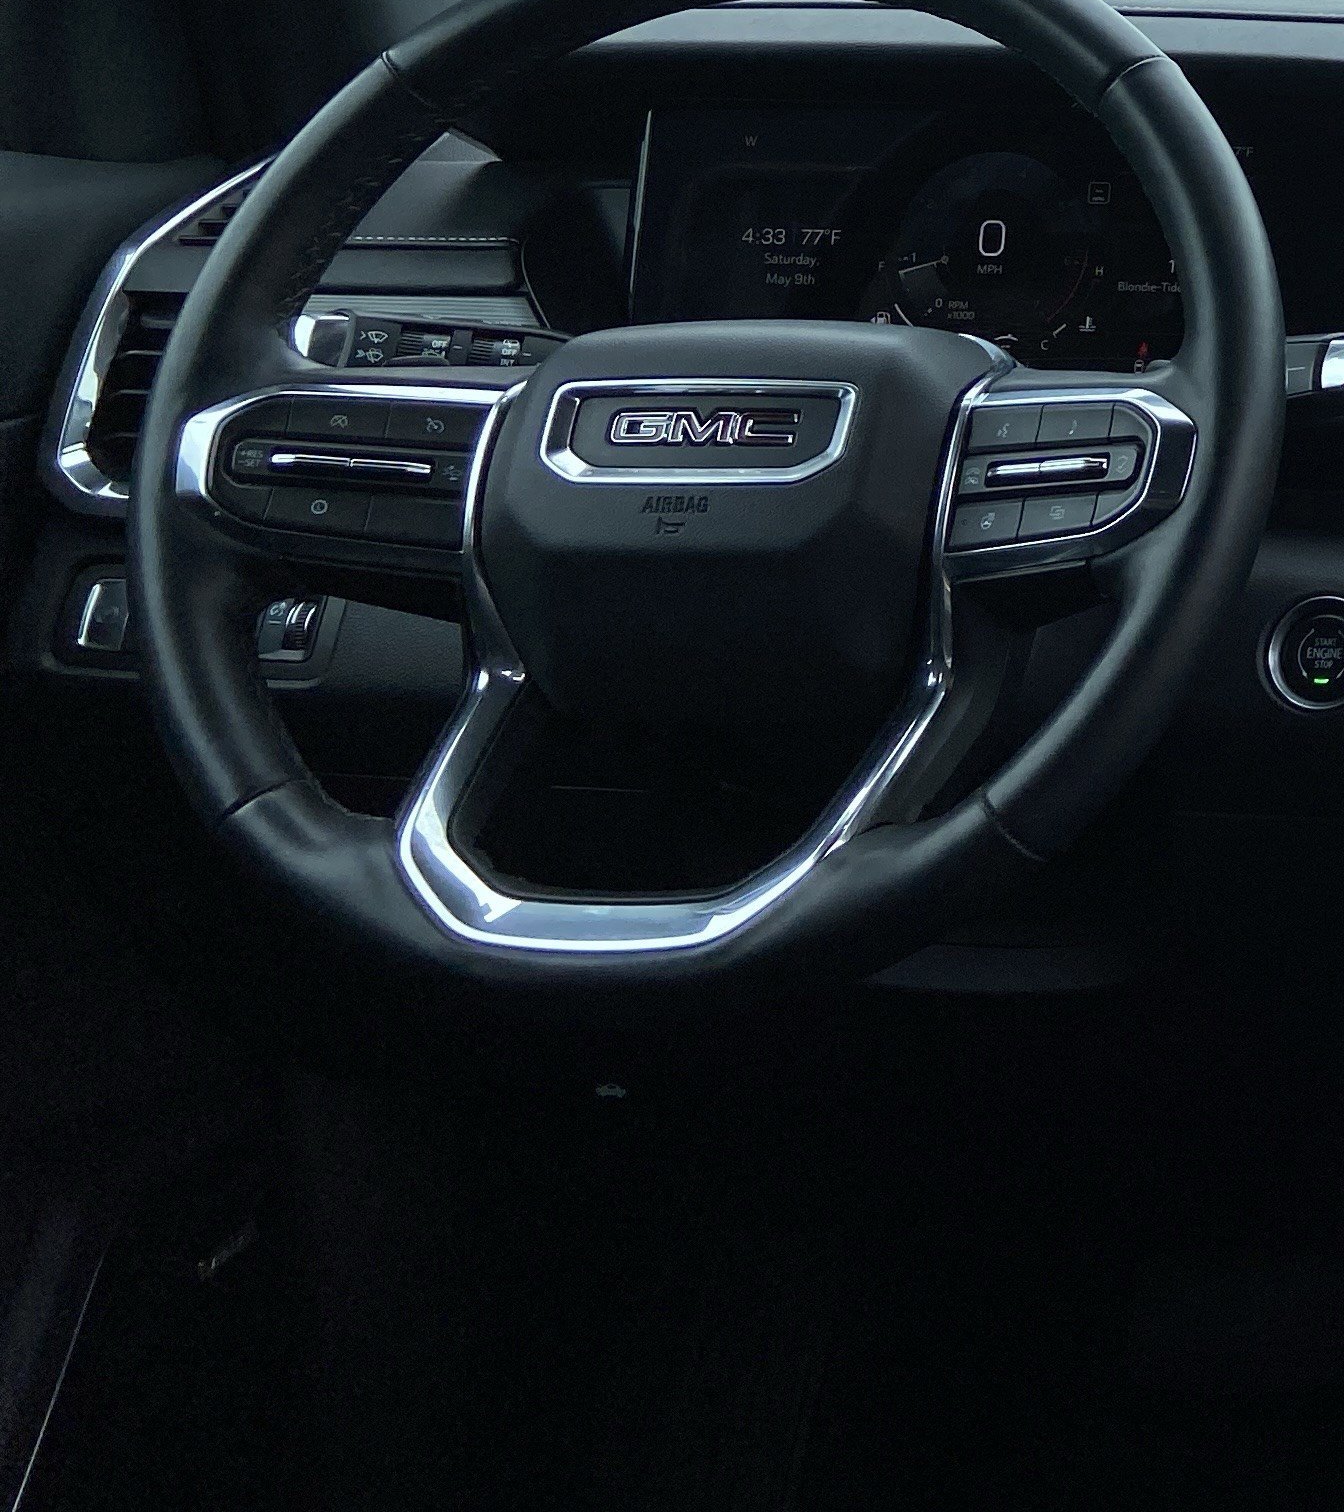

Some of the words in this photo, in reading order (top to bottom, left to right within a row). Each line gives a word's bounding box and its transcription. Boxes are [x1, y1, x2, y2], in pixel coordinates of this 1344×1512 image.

[744, 135, 758, 147] W
[741, 228, 787, 246] 4:33
[801, 228, 842, 246] 77°F
[978, 219, 1007, 257] 0
[763, 252, 820, 269] Saturday,
[976, 264, 1003, 275] MPH
[1095, 265, 1104, 276] H
[765, 273, 791, 287] May
[794, 272, 816, 285] 9th
[935, 297, 943, 308] 0
[948, 300, 969, 310] RPM
[432, 339, 449, 349] OFF
[1040, 339, 1049, 351] C
[501, 347, 517, 356] OFF
[609, 410, 801, 446] GMC
[640, 496, 709, 514] AIRBAG
[1314, 637, 1337, 647] START
[1306, 647, 1343, 659] ENGINE
[1314, 660, 1334, 669] STOP
